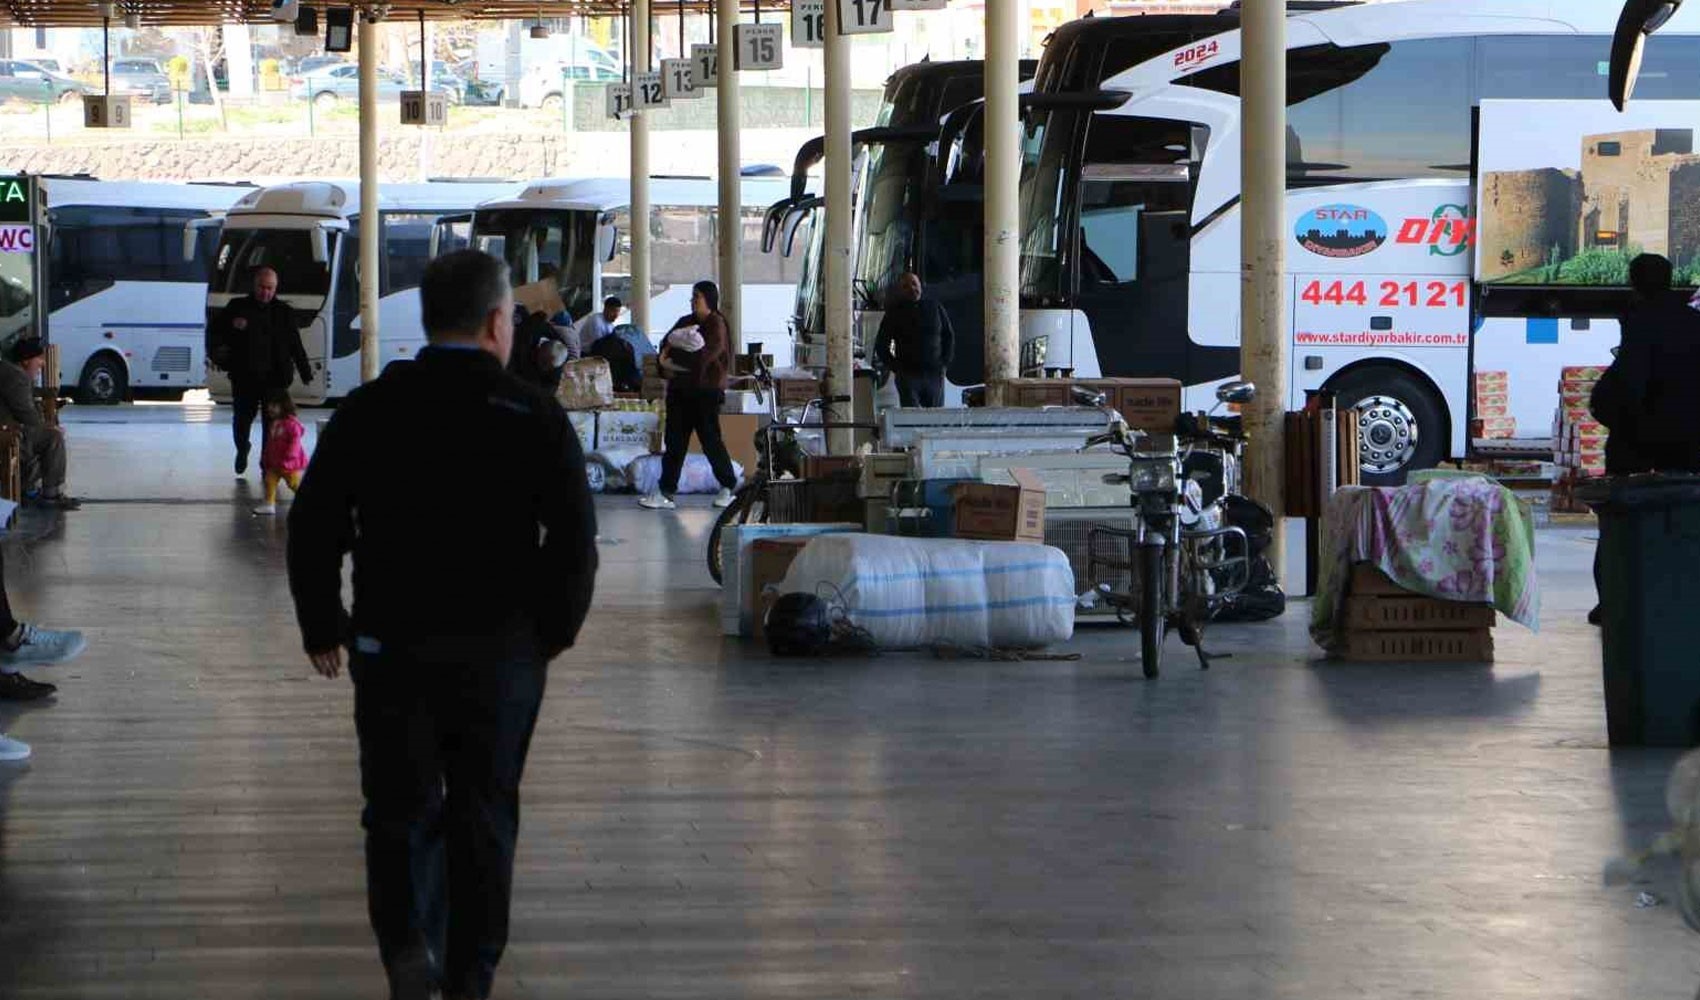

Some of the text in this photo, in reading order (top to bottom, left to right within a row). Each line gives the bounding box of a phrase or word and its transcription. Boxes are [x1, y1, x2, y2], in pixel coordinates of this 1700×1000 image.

[852, 0, 881, 26] 17
[749, 37, 774, 63] 15
[1174, 40, 1220, 66] 2024
[674, 70, 696, 92] 13
[640, 83, 662, 104] 12
[92, 105, 100, 123] 9
[405, 101, 420, 121] 10
[430, 102, 443, 121] 10
[0, 228, 32, 248] WC
[1301, 280, 1466, 307] 444 2121
